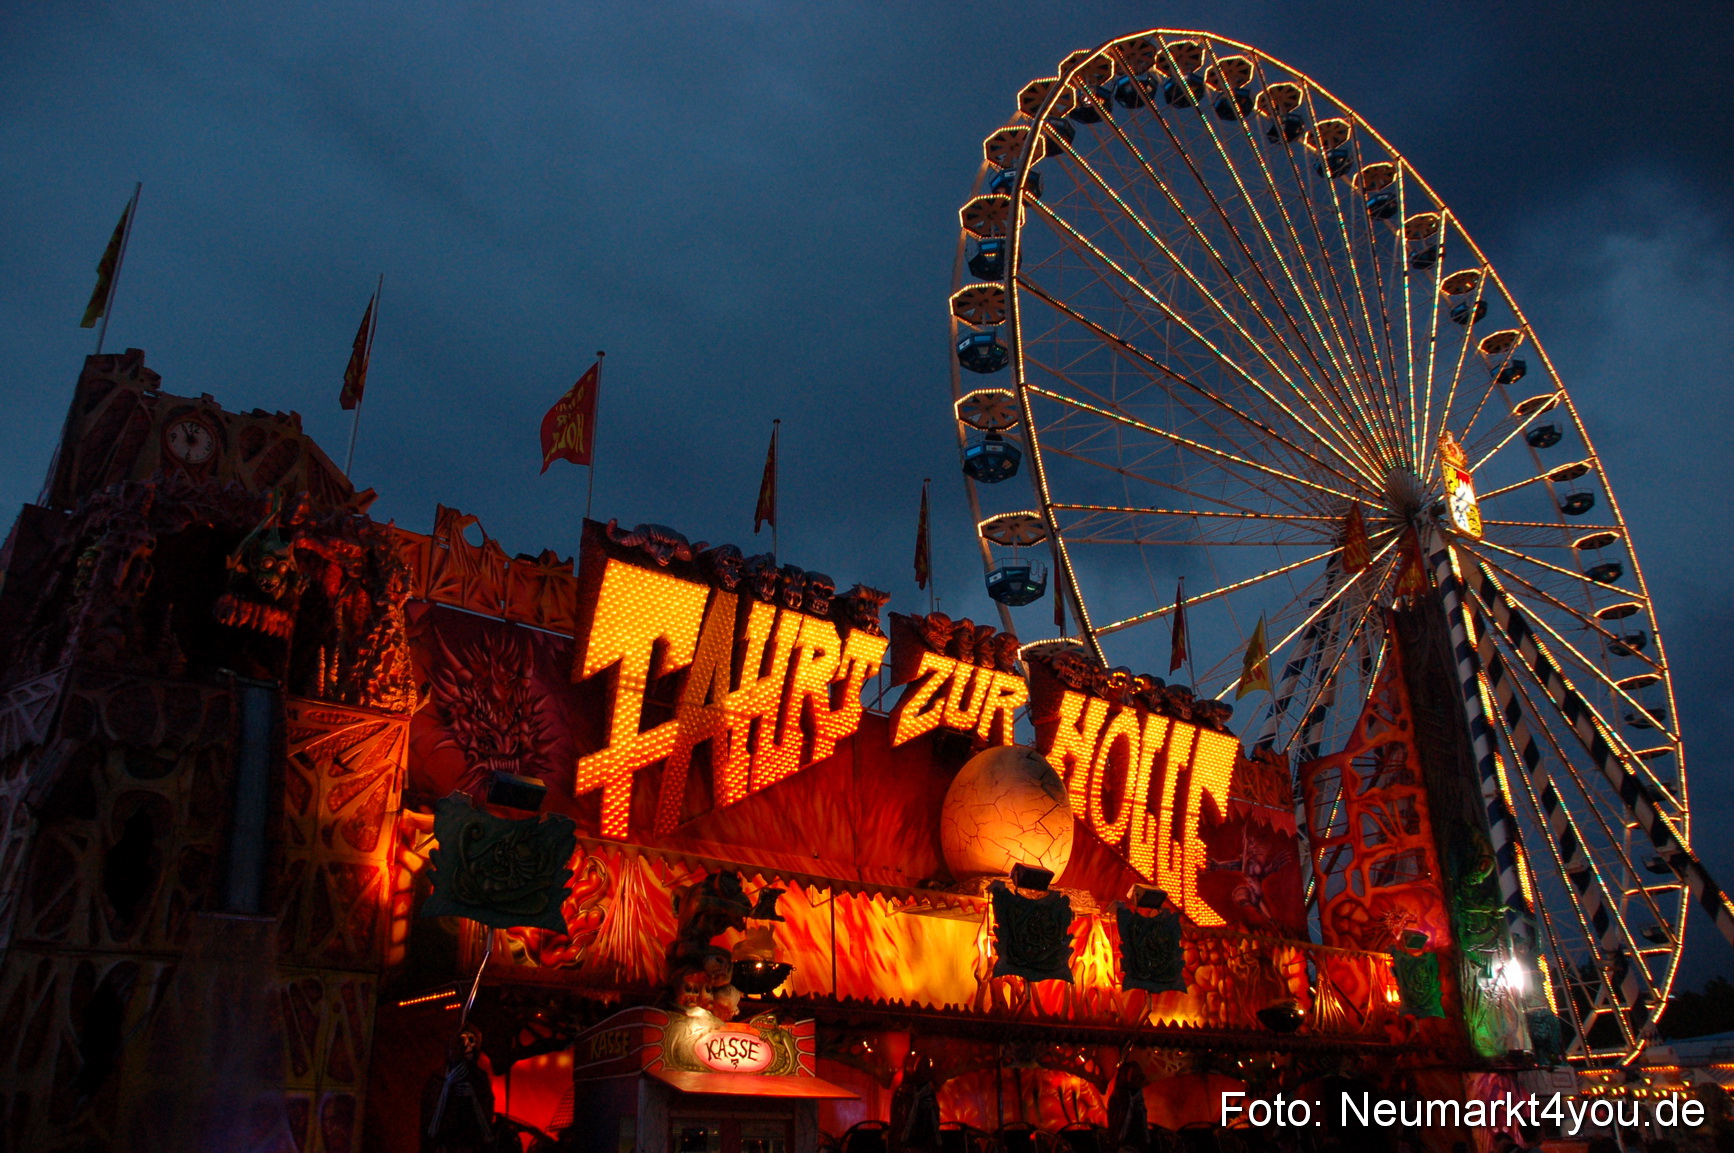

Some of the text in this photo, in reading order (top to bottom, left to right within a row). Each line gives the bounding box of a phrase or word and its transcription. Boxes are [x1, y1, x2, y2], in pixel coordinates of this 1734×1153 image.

[575, 557, 890, 840] FAHRT
[892, 651, 1030, 748] ZUR
[590, 1031, 631, 1060] KASSE
[705, 1037, 762, 1062] KASSE
